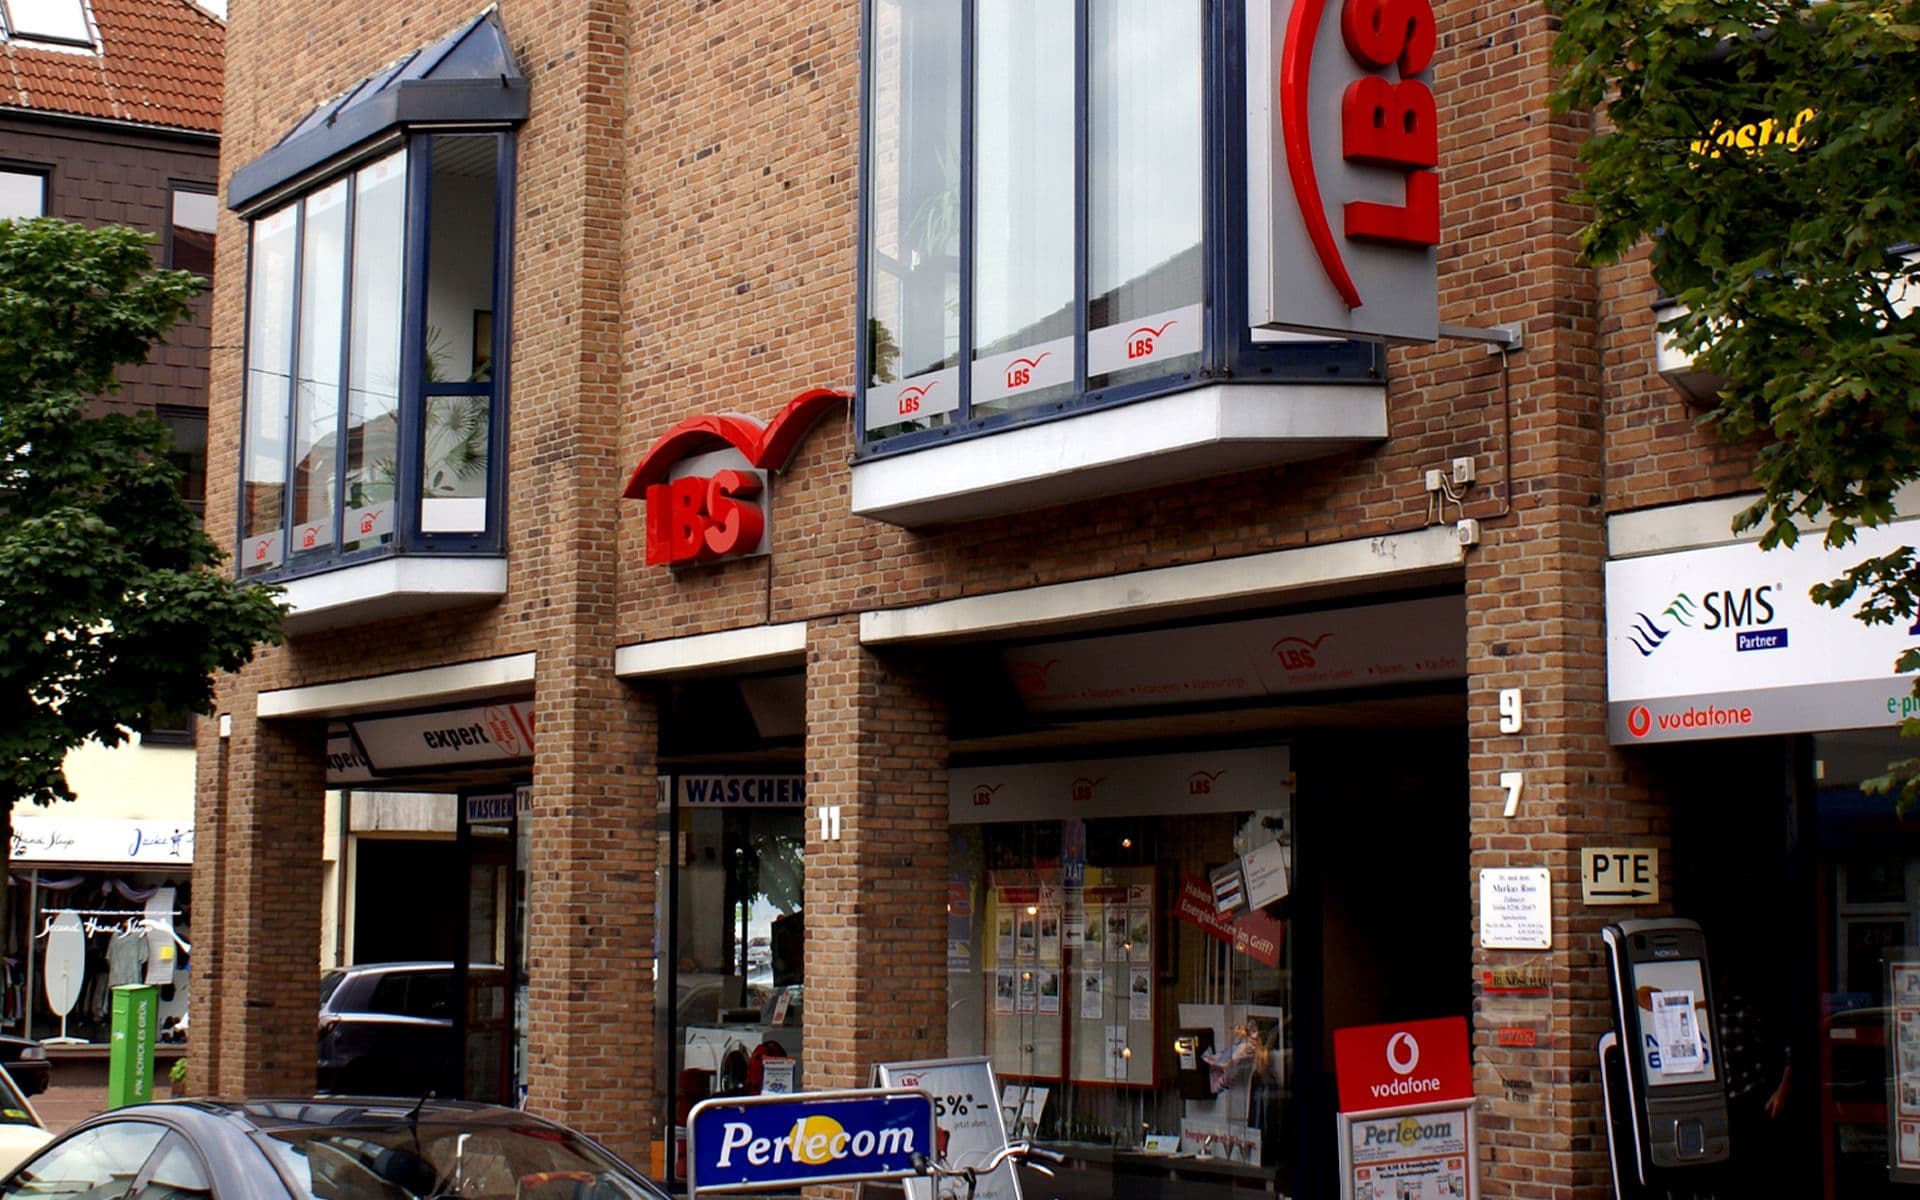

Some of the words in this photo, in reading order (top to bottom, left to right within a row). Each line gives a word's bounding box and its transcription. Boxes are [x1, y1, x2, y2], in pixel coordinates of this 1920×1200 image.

[1341, 0, 1441, 248] LBS
[1128, 336, 1154, 360] LBS
[1007, 367, 1030, 389] LBS
[899, 395, 920, 415] LBS
[361, 520, 373, 534] LBS
[646, 469, 764, 566] LBS
[303, 534, 315, 548] LBS
[256, 547, 266, 560] LBS
[1703, 585, 1774, 631] SMS
[1738, 635, 1778, 650] Partner
[1278, 649, 1315, 669] LBS
[1500, 688, 1522, 734] 9
[1657, 703, 1753, 730] vodafone
[423, 722, 490, 752] expert
[686, 779, 806, 804] WASCHEN
[973, 792, 990, 806] LBS
[1072, 786, 1092, 801] LBS
[1190, 779, 1211, 795] LBS
[1500, 771, 1524, 817] 7
[469, 795, 513, 819] WASCHEN
[818, 806, 841, 841] 11
[1592, 854, 1649, 884] PTE
[1185, 881, 1213, 905] Haben
[84, 916, 123, 939] Hand
[118, 916, 153, 939] Shop
[1237, 927, 1249, 944] im
[1249, 934, 1275, 957] Griff?
[901, 1078, 919, 1087] LBS
[1370, 1076, 1441, 1098] vodafone
[715, 1117, 914, 1168] Perlecom
[1363, 1120, 1453, 1146] Perlecom
